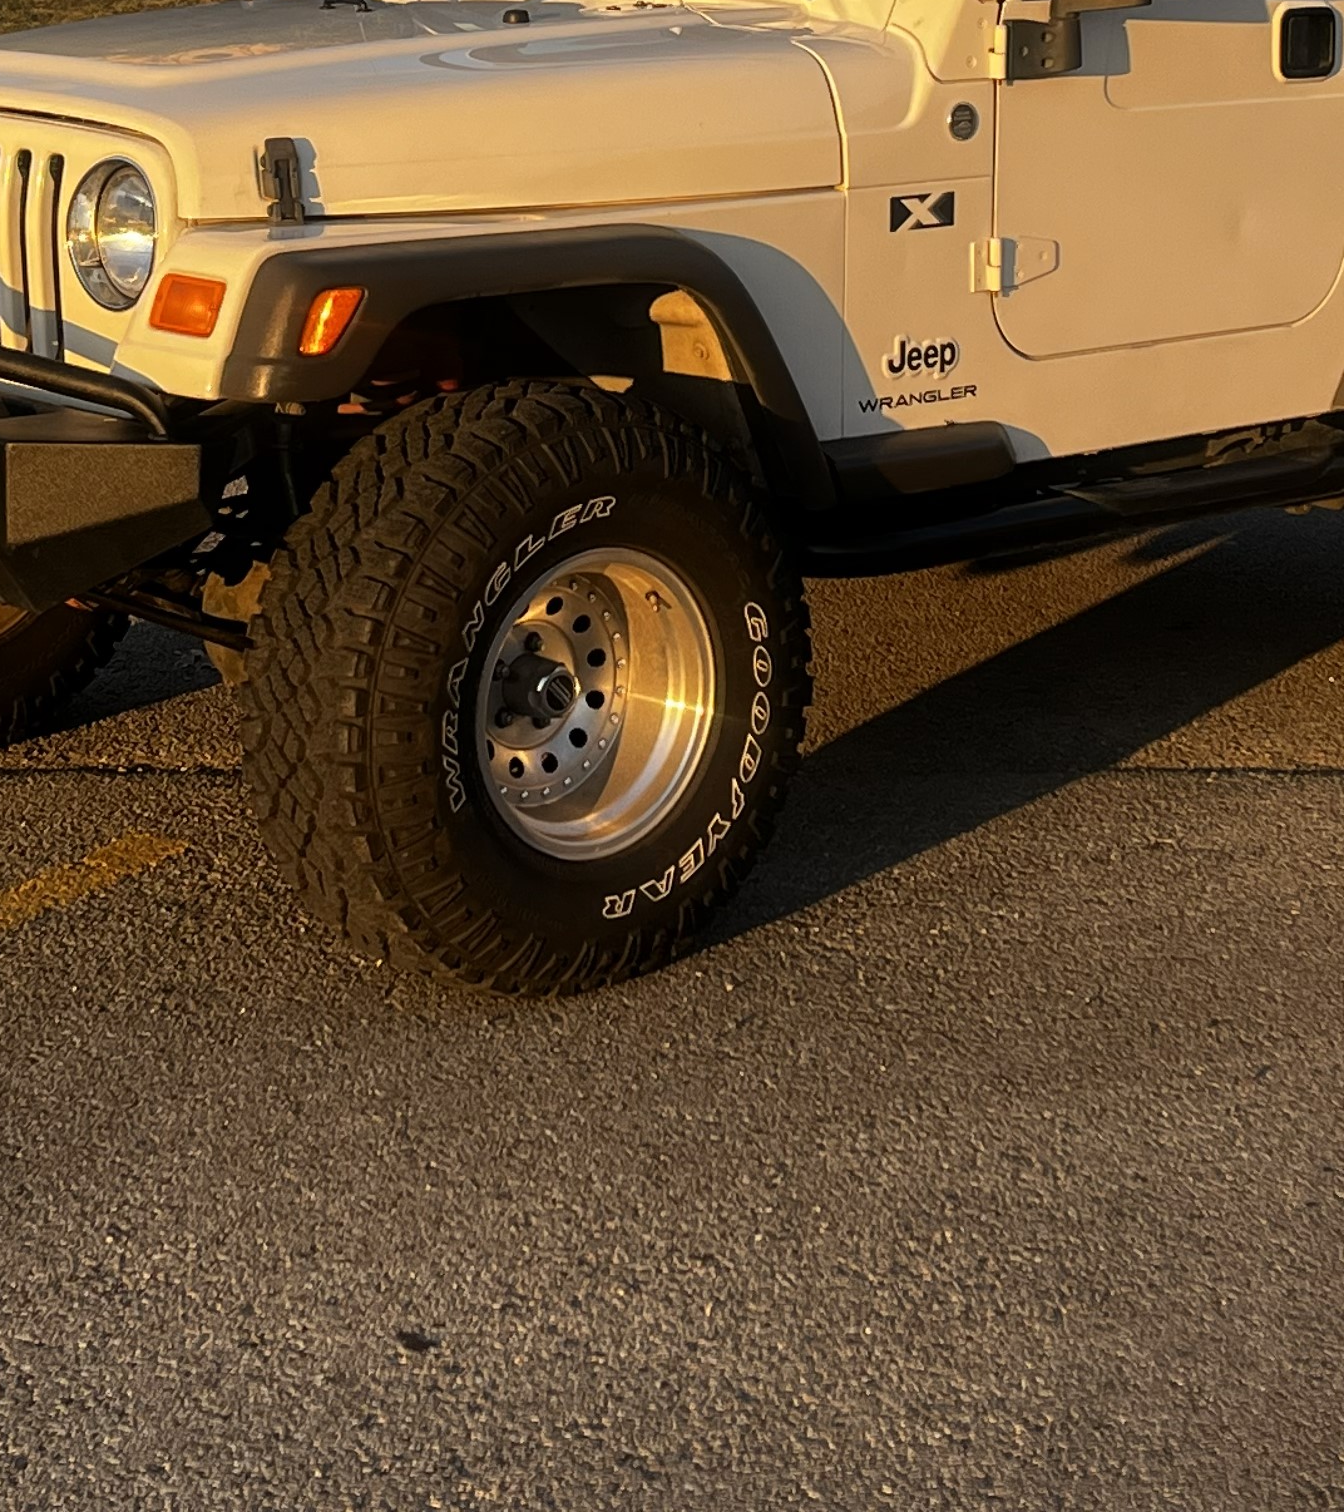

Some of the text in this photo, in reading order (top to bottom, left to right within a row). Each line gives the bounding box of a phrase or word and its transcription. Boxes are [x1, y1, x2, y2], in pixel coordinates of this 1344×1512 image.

[891, 191, 954, 232] X
[885, 337, 958, 377] Jeep
[859, 384, 977, 413] WRANGLER
[442, 495, 616, 813] WRANGLER
[602, 601, 772, 919] GOODYEAR
